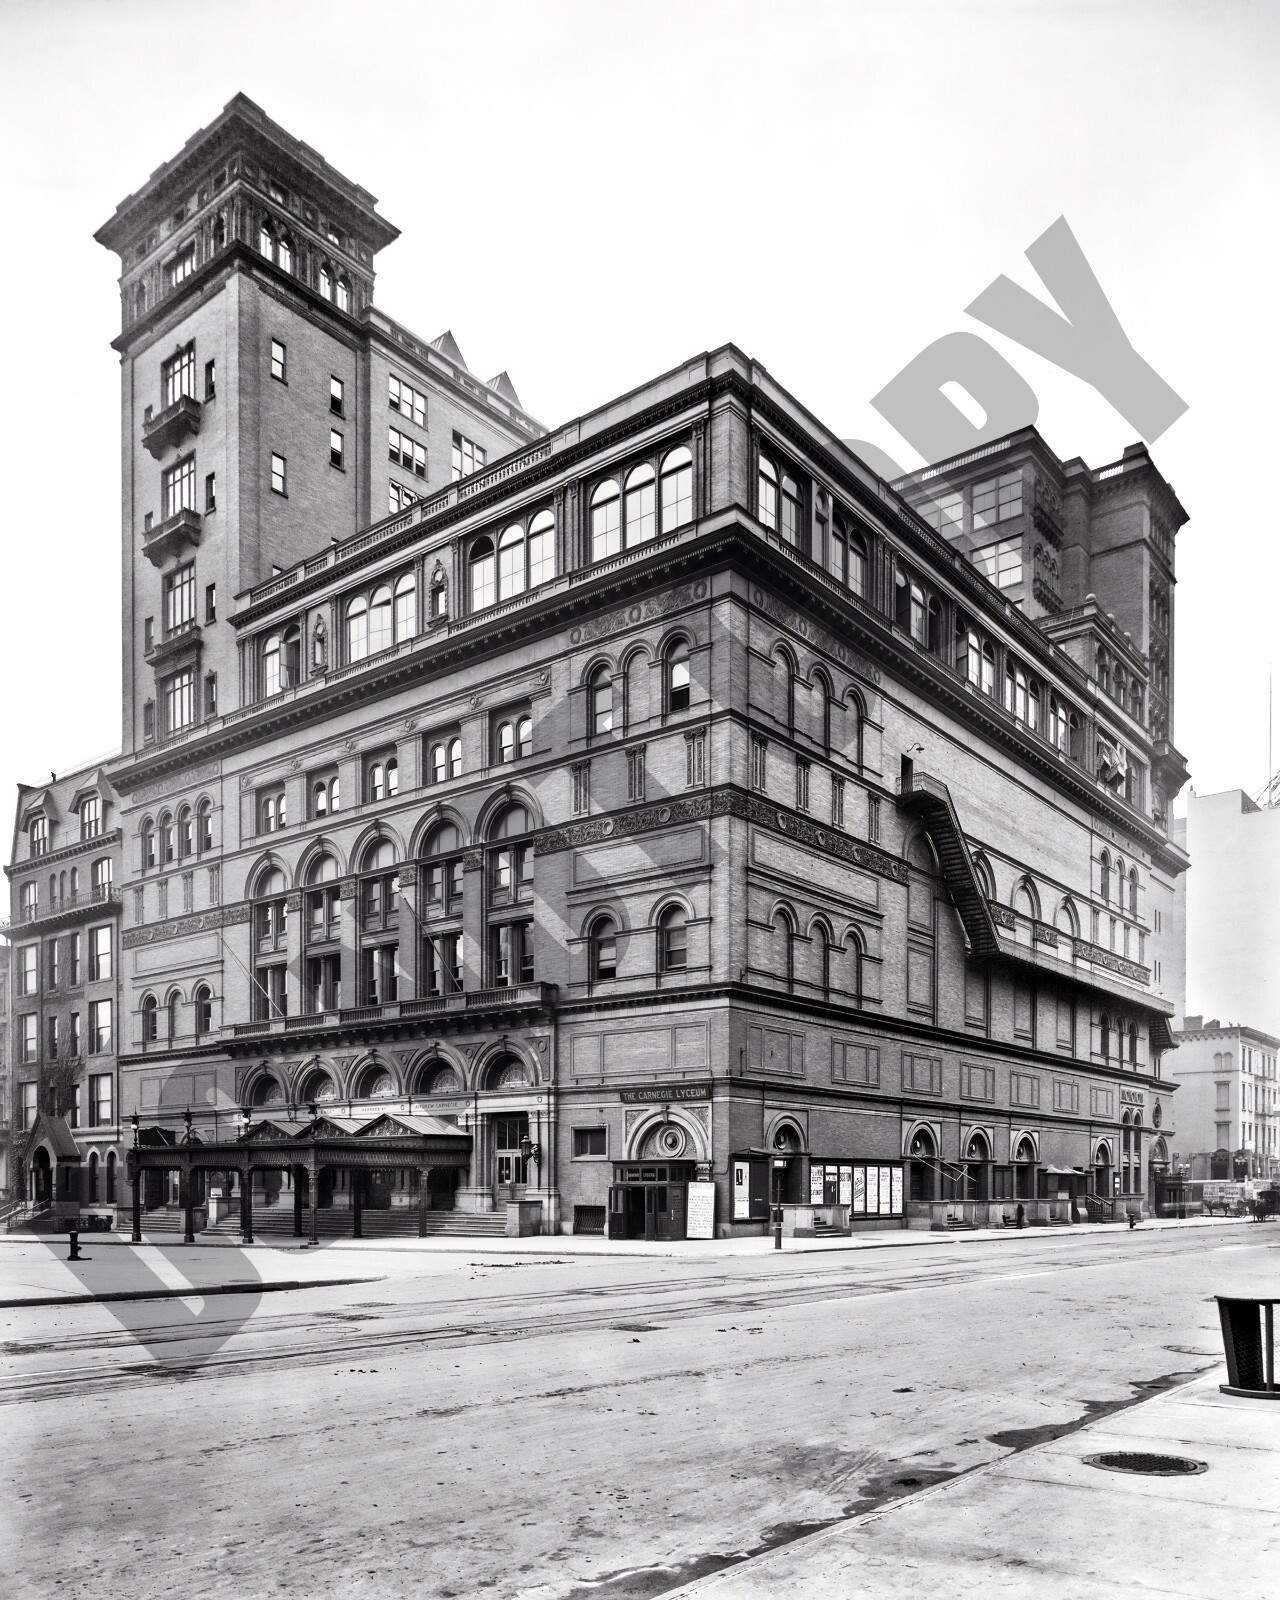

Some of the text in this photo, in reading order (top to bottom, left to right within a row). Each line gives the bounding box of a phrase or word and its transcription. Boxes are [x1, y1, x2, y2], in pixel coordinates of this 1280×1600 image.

[622, 1087, 707, 1101] THE CARNEGIE LYCEUM
